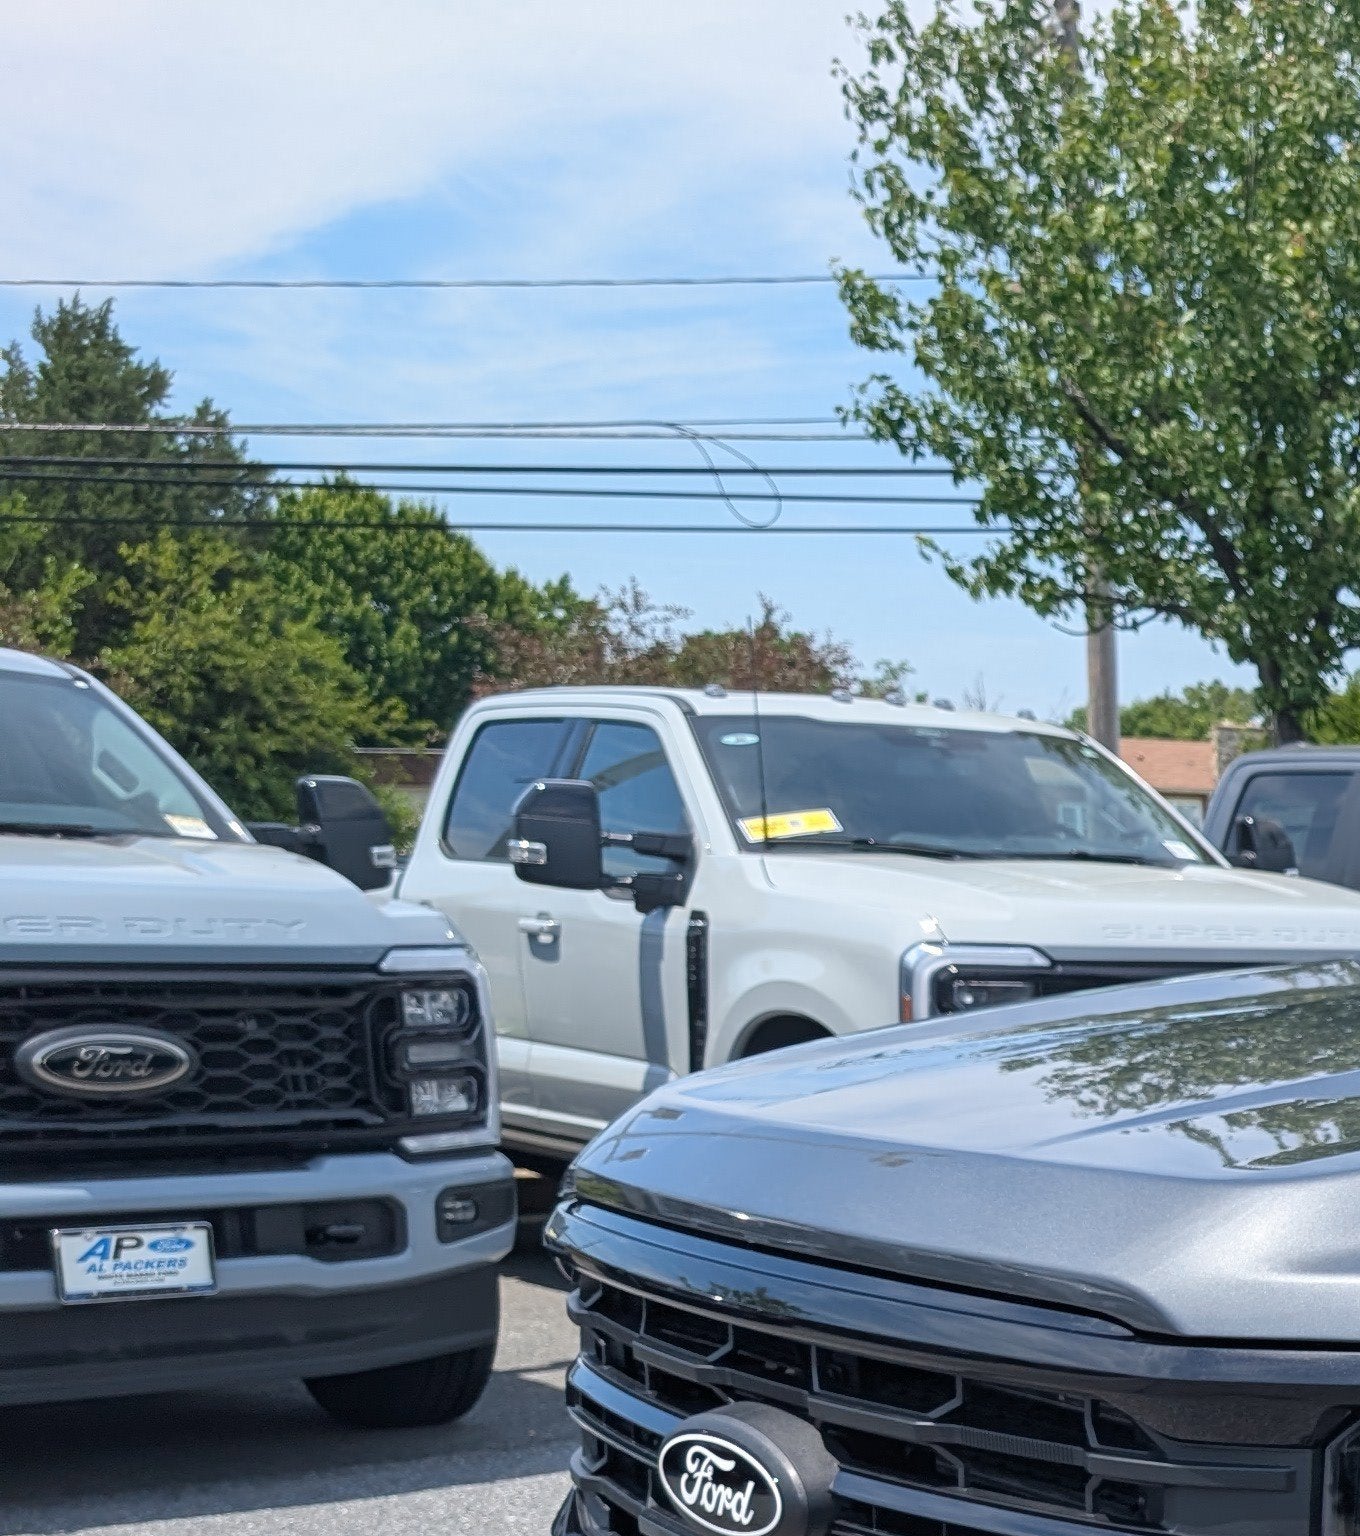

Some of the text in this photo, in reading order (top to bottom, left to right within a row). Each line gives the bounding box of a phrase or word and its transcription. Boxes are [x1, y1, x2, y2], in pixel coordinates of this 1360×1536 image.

[121, 915, 306, 941] DUTY
[71, 1045, 154, 1079] Ford
[77, 1236, 144, 1264] AP
[86, 1257, 188, 1274] AL PACKERS
[680, 1445, 755, 1526] Ford
